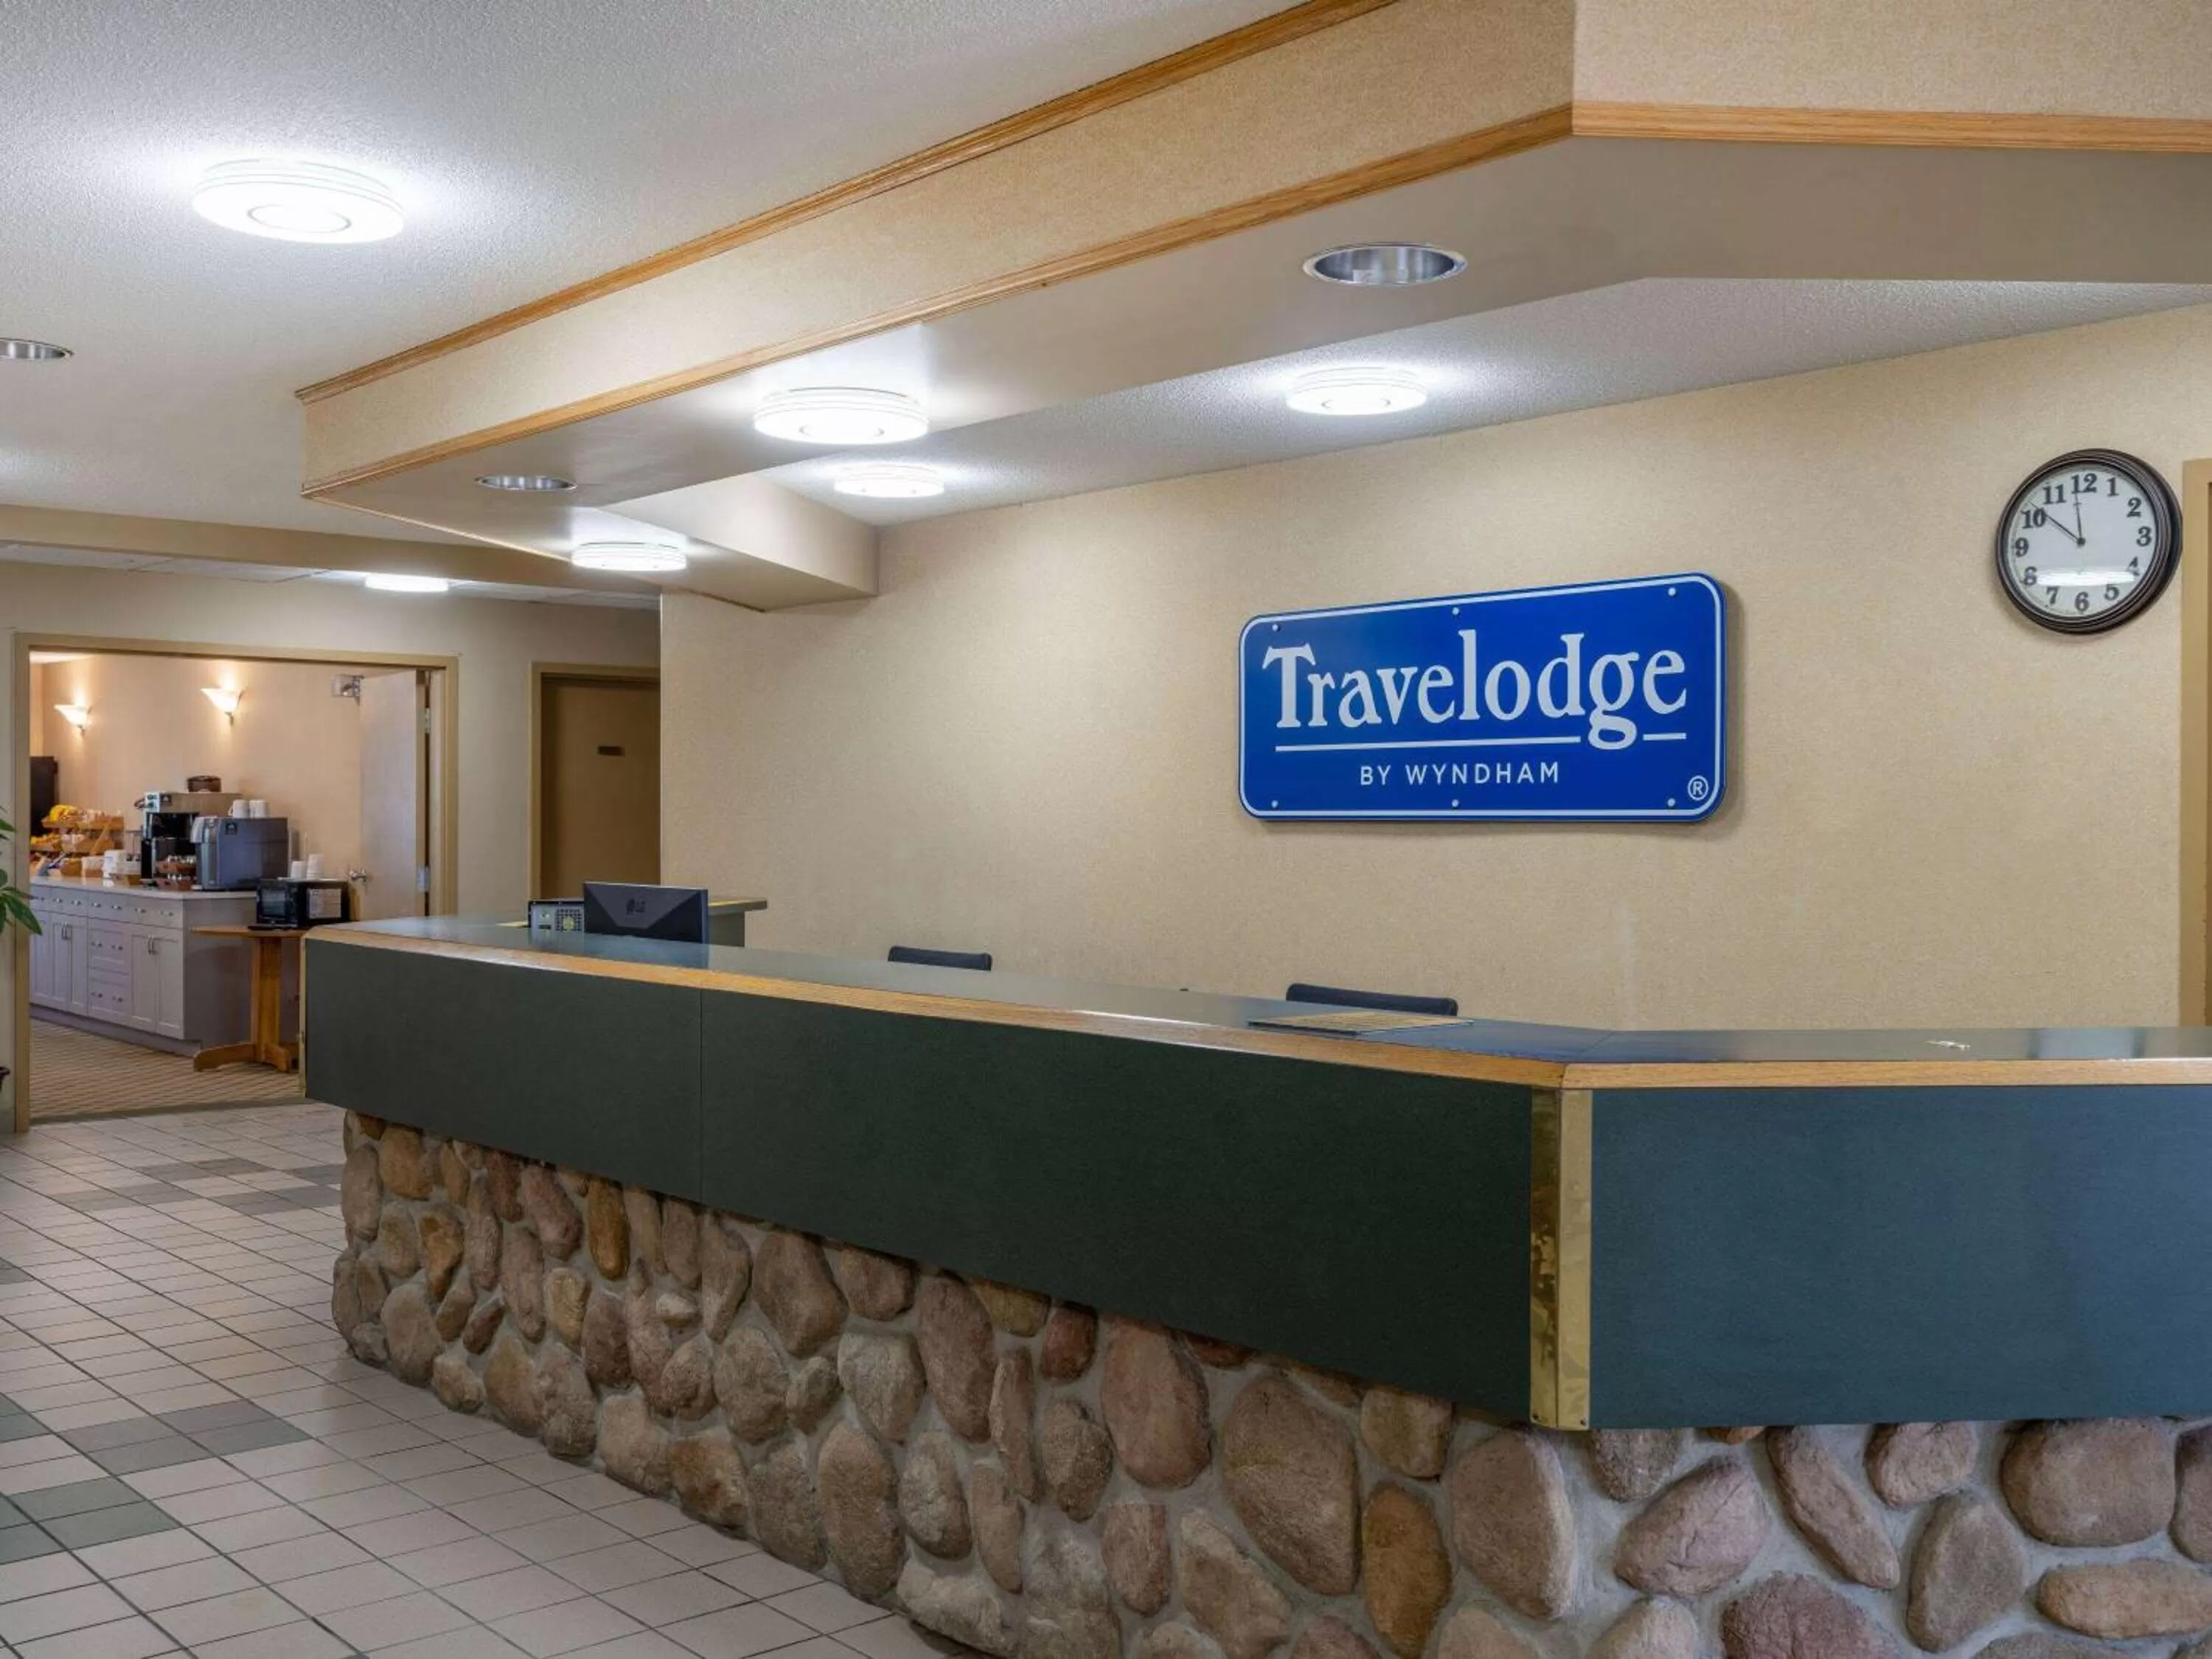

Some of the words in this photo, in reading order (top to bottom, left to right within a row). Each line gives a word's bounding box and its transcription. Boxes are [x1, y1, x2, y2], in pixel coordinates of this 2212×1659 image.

[2043, 484, 2067, 504] 11
[2071, 473, 2098, 495] 12
[2107, 478, 2119, 496] 1
[2021, 507, 2046, 529] 10
[2126, 498, 2142, 518] 2
[2136, 526, 2152, 546] 3
[2015, 538, 2029, 557] 9
[2023, 566, 2037, 585] 8
[2046, 586, 2059, 605] 7
[2075, 591, 2089, 611] 6
[2104, 584, 2119, 600] 5
[1262, 630, 1687, 750] Travelodge
[1360, 765, 1391, 786] BY
[1405, 762, 1559, 785] WYNDHAM
